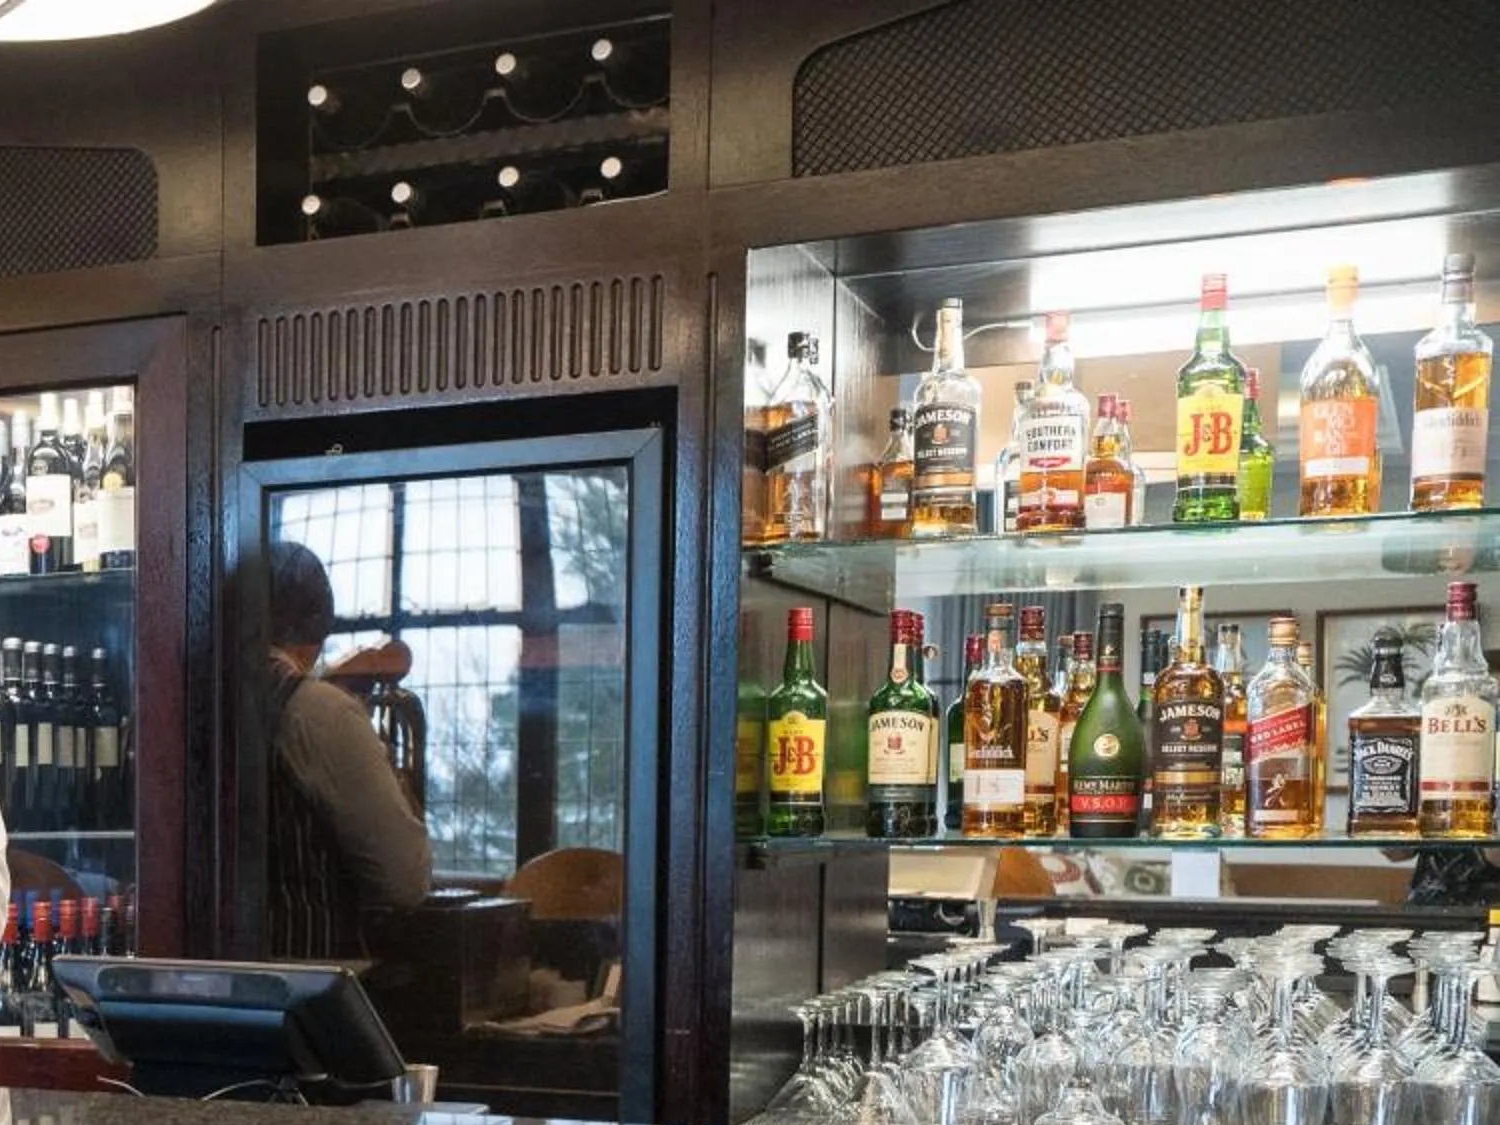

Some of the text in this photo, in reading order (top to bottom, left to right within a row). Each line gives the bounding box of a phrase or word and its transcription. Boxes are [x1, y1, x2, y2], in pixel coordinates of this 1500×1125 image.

[915, 409, 971, 428] JAMESON
[1027, 425, 1076, 440] SOUTHERN
[1183, 411, 1233, 456] J&B
[1027, 439, 1073, 452] COMFORT
[1159, 704, 1221, 722] JAMESON
[869, 717, 924, 732] JAMESON
[1272, 721, 1307, 735] LABEL
[1428, 716, 1487, 733] BELL'S
[773, 735, 816, 776] J&B
[1161, 745, 1187, 753] SELECT
